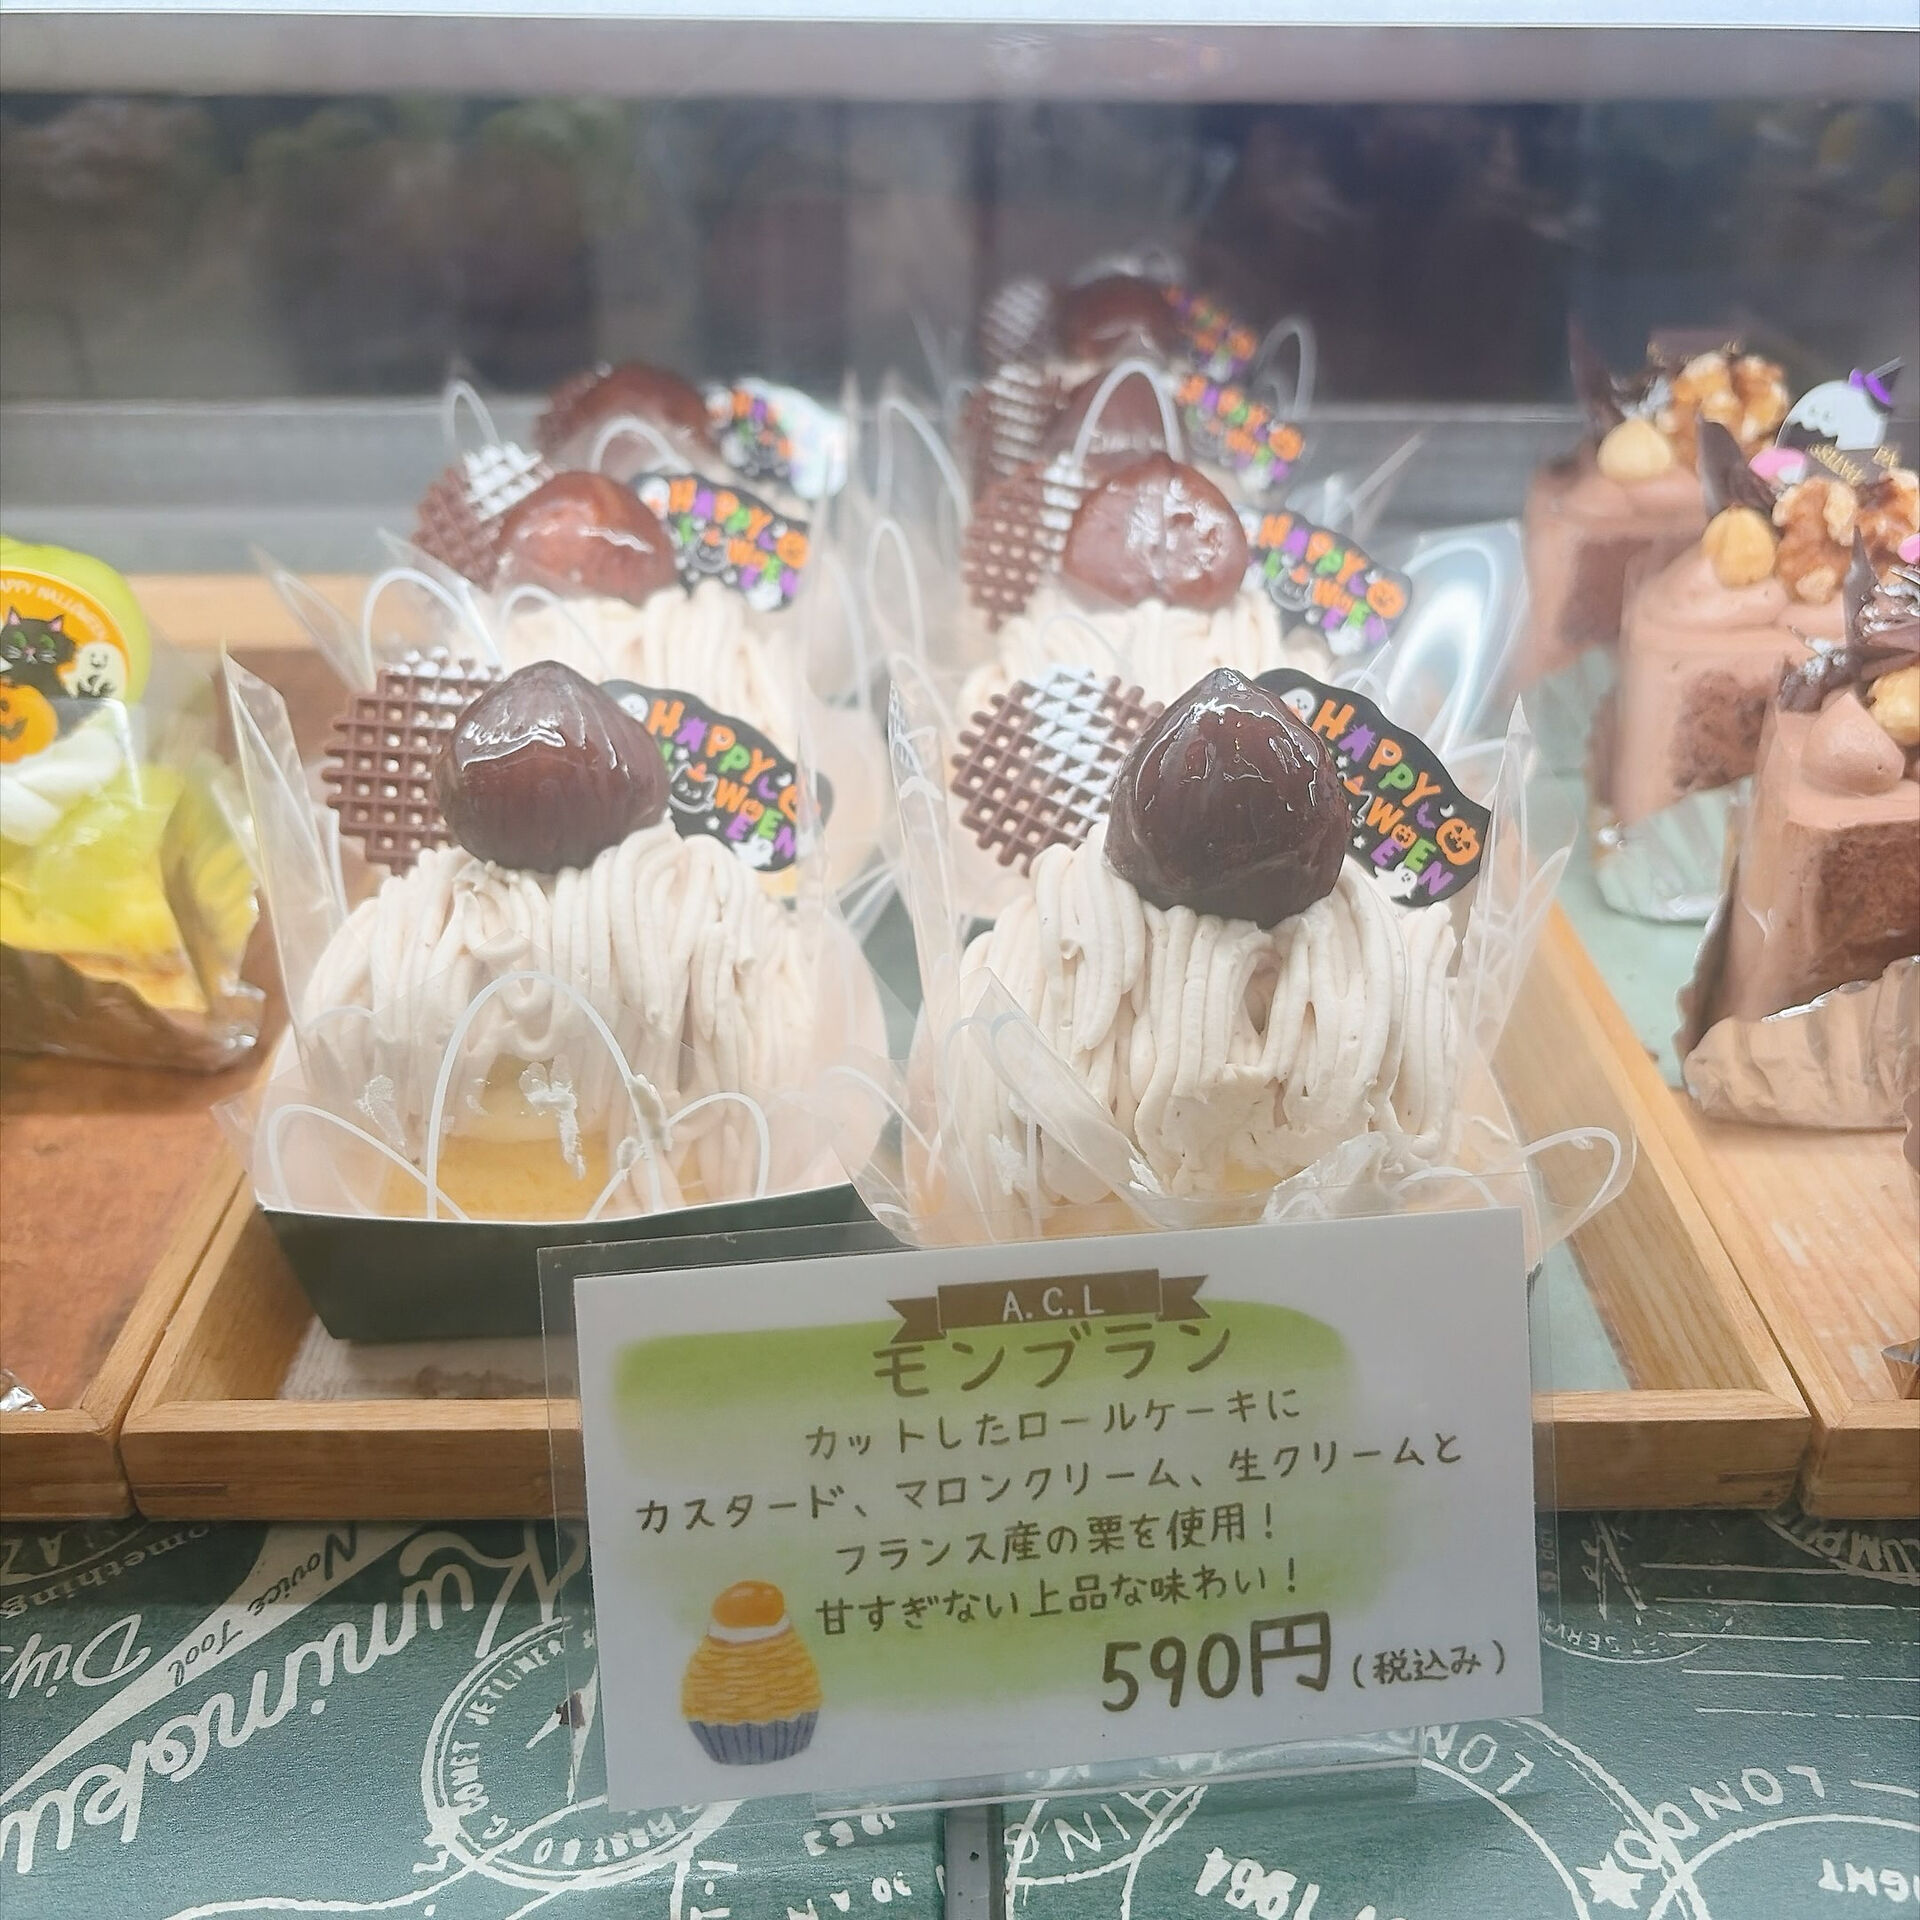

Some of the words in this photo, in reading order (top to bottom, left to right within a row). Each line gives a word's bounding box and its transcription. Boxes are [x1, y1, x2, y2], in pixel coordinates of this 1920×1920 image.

[648, 699, 776, 785] HAPPY
[1310, 699, 1442, 808] HAPPY
[1002, 1283, 1106, 1322] A.C.L
[874, 1320, 1231, 1397] モンブラン
[805, 1388, 1300, 1460] カットしたロールケーキに
[635, 1433, 1463, 1534] カスタード、マロンクリーム、生クリームと
[835, 1502, 1275, 1576] フランス産の栗を使用！
[815, 1557, 1300, 1637] 甘すぎない上品な味わい！
[167, 1628, 244, 1687] Tool
[1101, 1610, 1333, 1712] 590円
